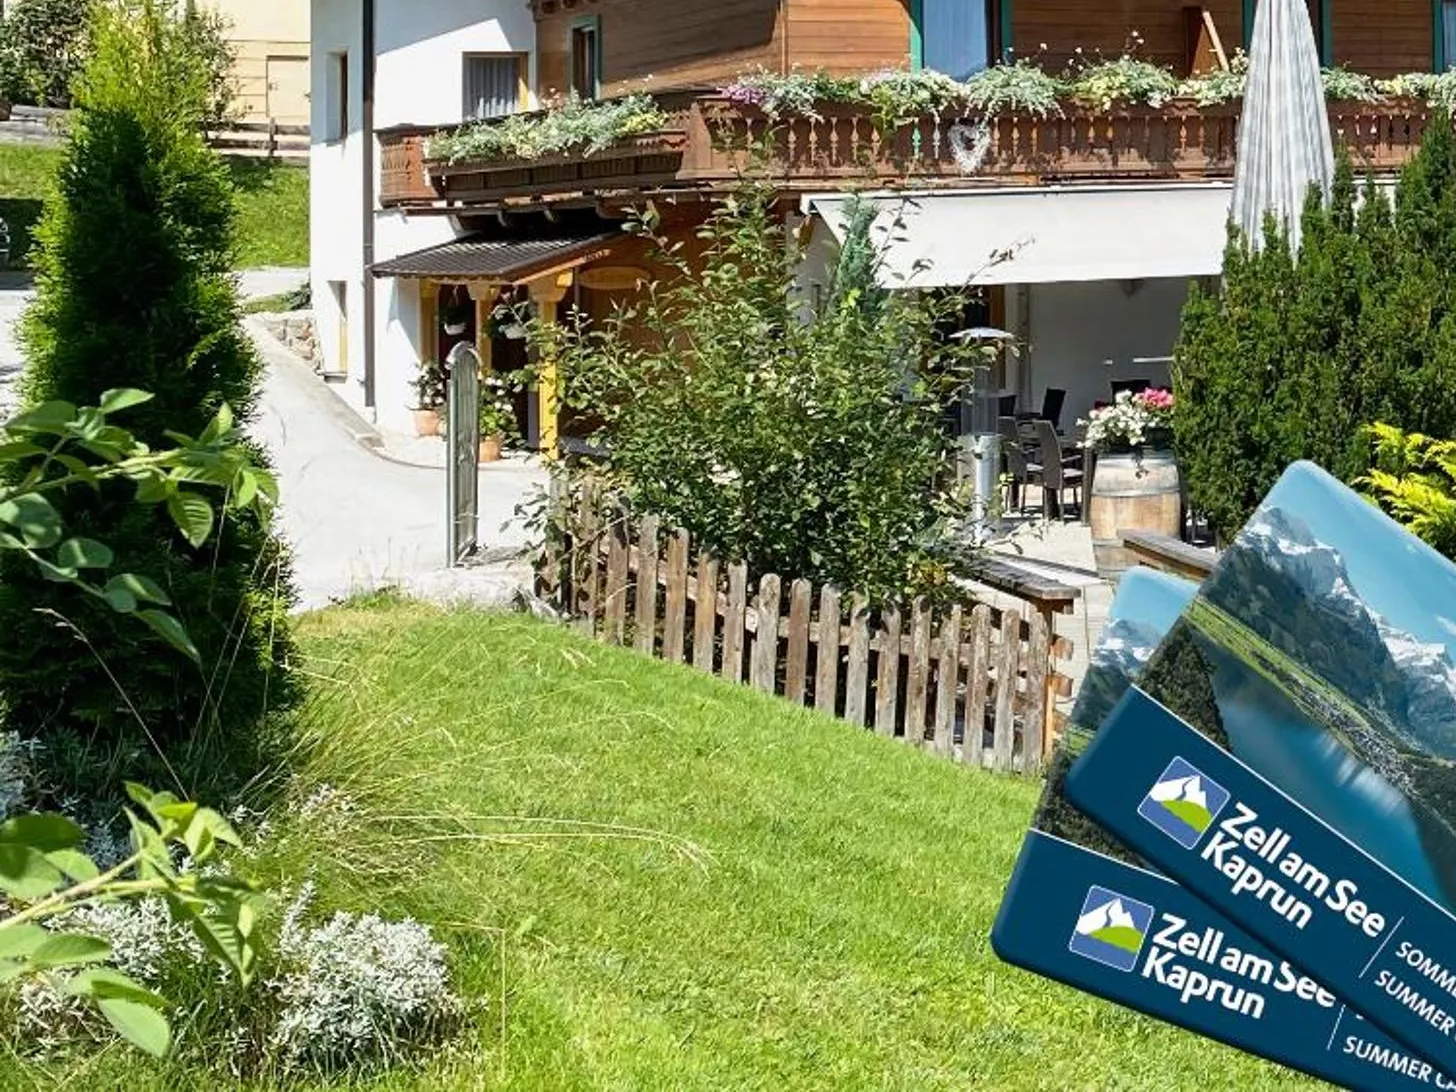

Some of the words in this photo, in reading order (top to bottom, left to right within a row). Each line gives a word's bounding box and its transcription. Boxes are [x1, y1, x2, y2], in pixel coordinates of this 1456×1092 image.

[1201, 830, 1313, 930] Kaprun
[1219, 801, 1292, 864] Zell
[1278, 852, 1330, 899] am
[1324, 879, 1386, 938] See
[1142, 946, 1265, 1019] Kaprun
[1152, 912, 1224, 964] Zell
[1220, 947, 1272, 985] am
[1374, 969, 1456, 1036] SUMMER
[1343, 1035, 1432, 1083] SUMMER
